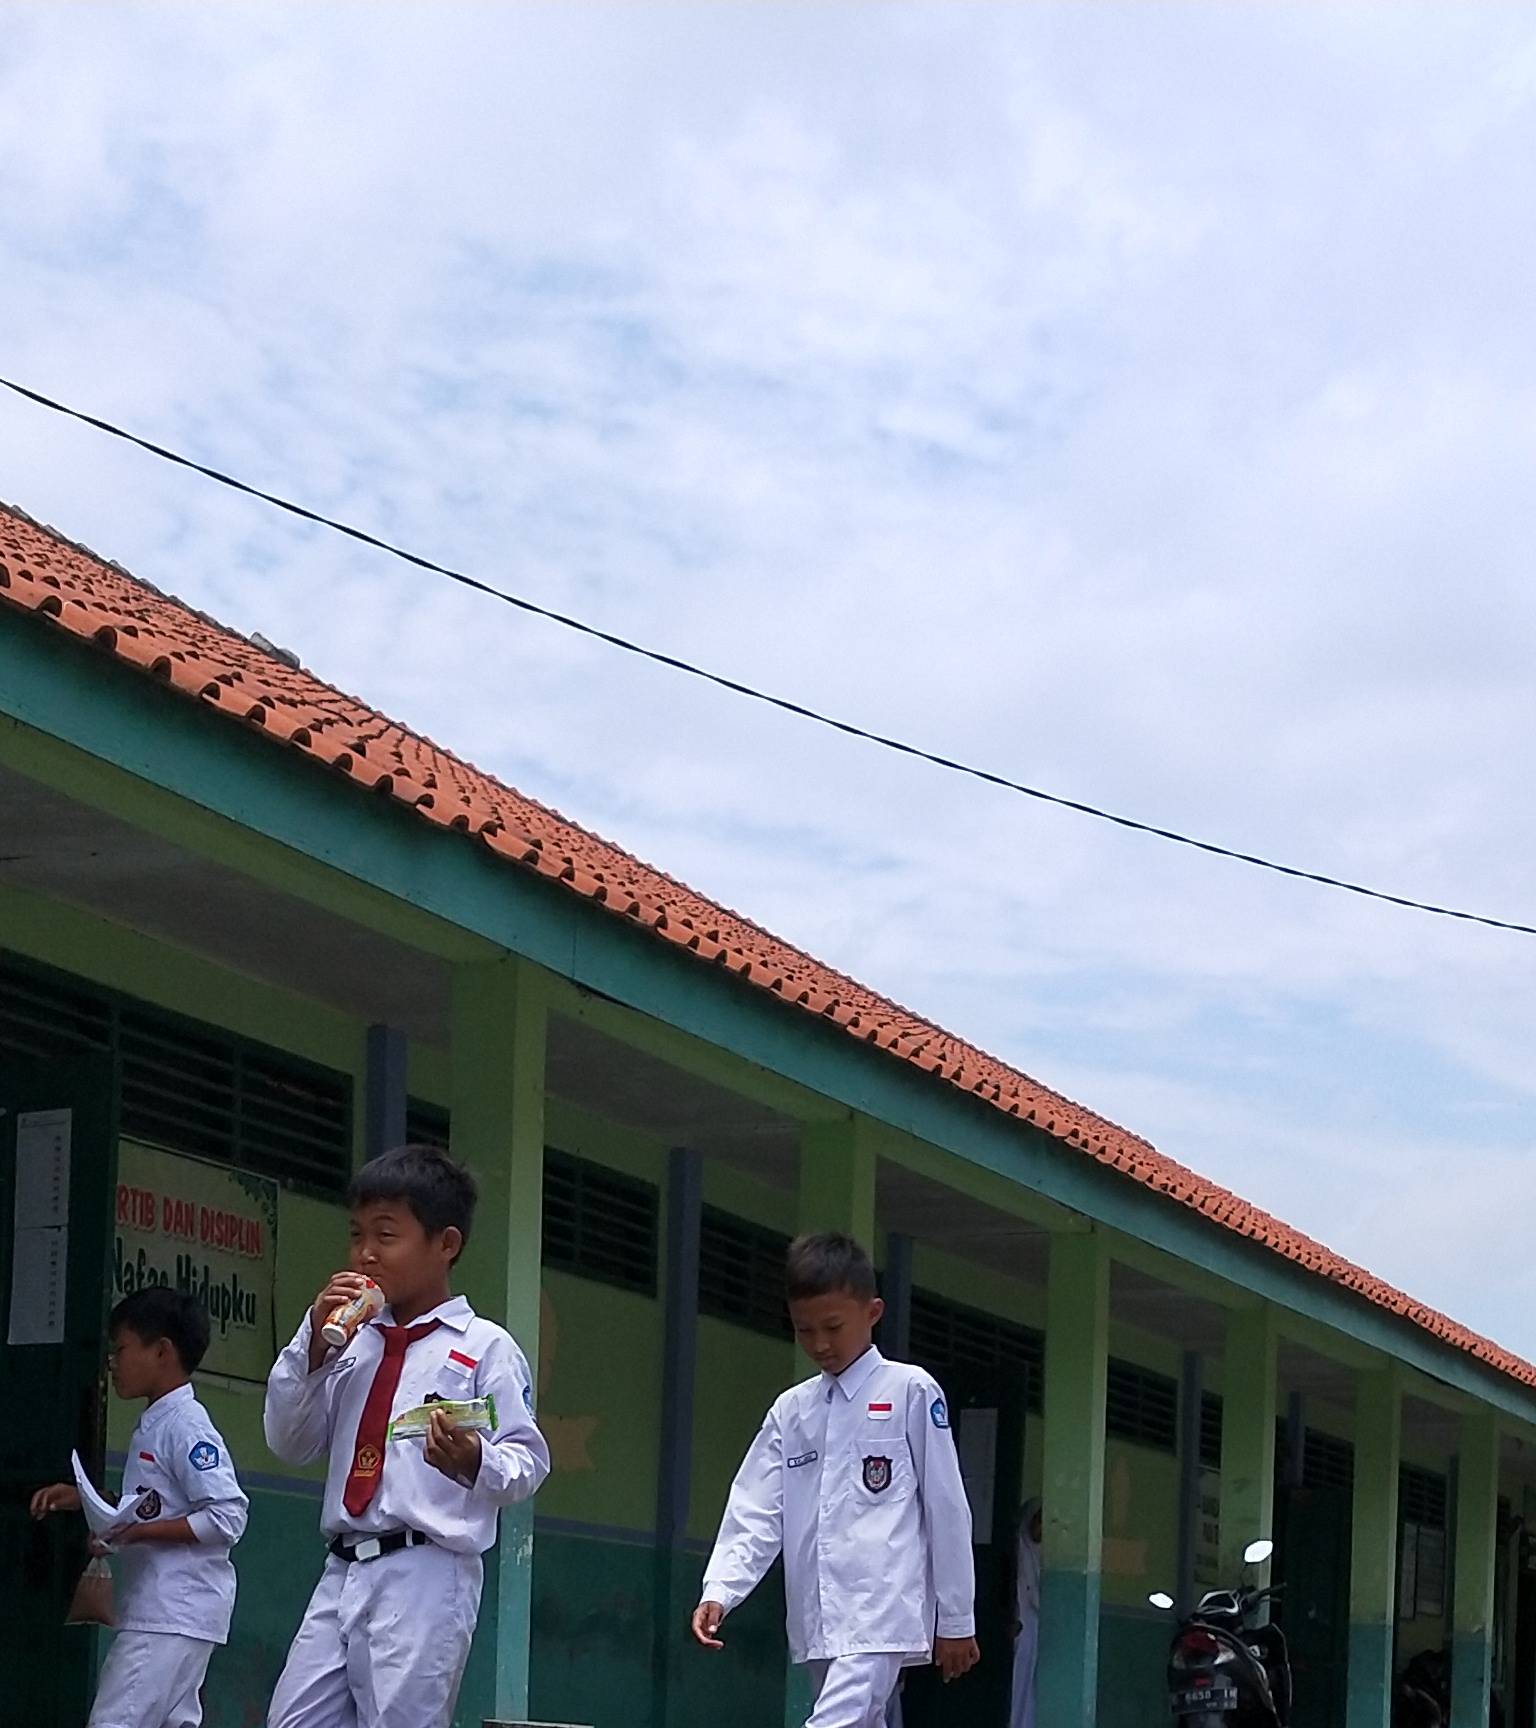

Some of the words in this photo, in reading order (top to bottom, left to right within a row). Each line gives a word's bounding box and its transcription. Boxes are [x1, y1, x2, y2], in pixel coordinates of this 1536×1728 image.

[116, 1183, 156, 1228] RTIB
[162, 1196, 195, 1238] DAN
[199, 1206, 263, 1255] DISIPLIN
[176, 1253, 256, 1335] Hidupku
